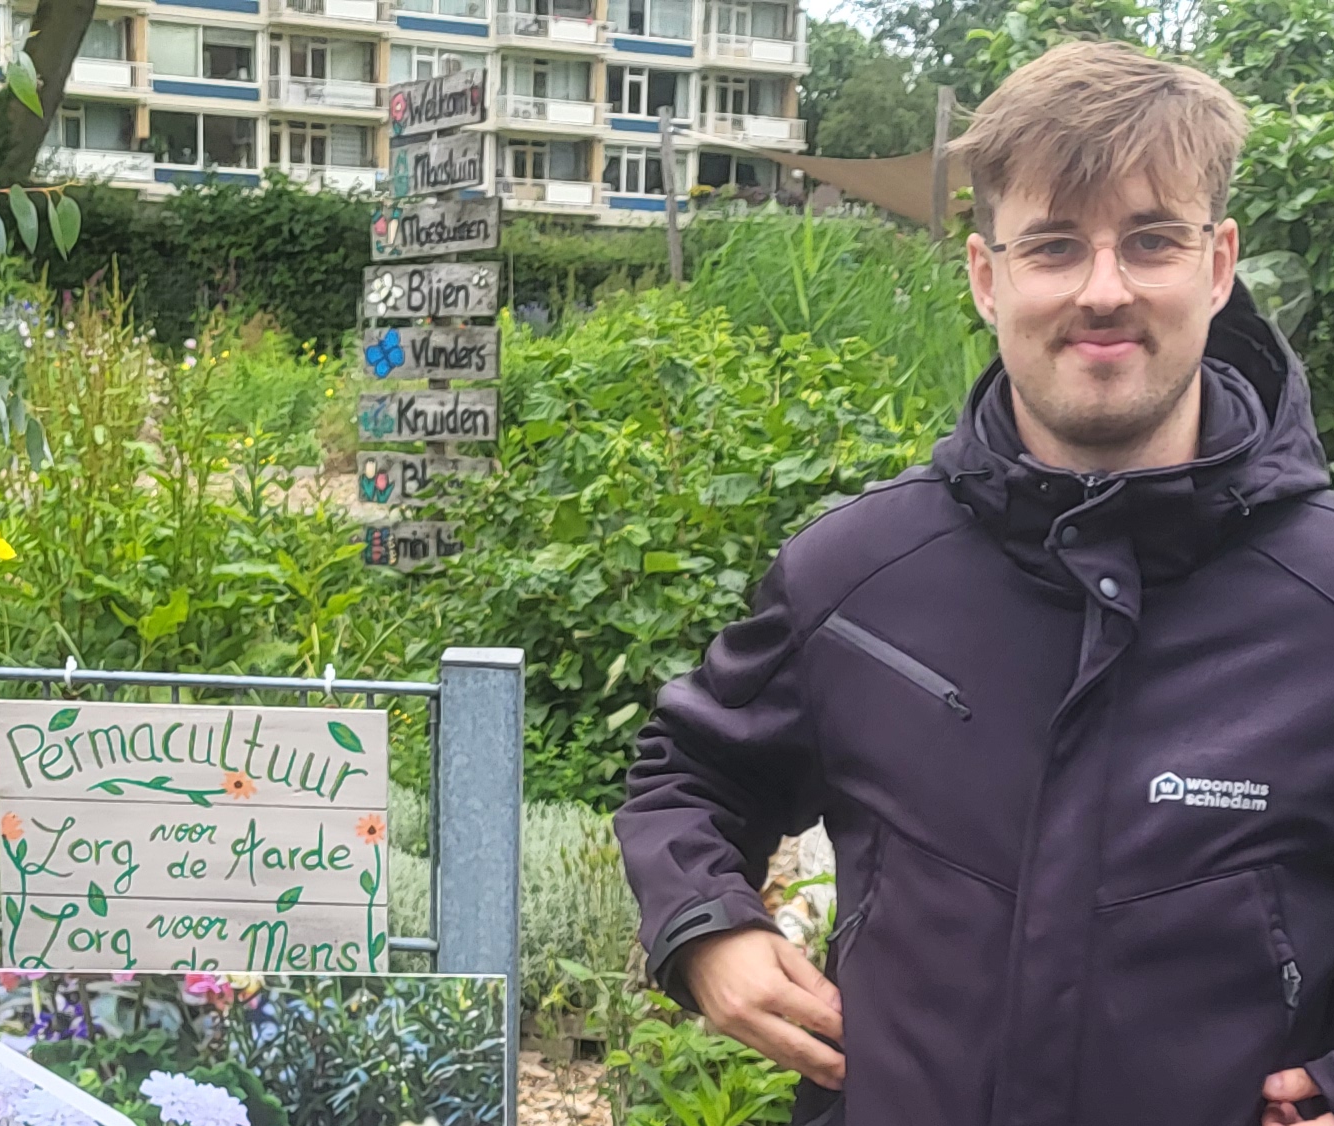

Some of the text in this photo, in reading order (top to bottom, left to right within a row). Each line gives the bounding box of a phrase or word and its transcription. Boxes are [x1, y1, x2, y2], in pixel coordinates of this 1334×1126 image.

[407, 269, 470, 316] Bijen
[397, 392, 489, 436] Kruiden
[6, 709, 369, 802] Permacultuur
[1184, 777, 1270, 796] woonplus
[1184, 792, 1268, 812] schiedam
[23, 816, 354, 894] Zorg voor de Aarde
[19, 902, 137, 971] Zorg
[147, 914, 229, 941] voor
[239, 920, 362, 973] Mens
